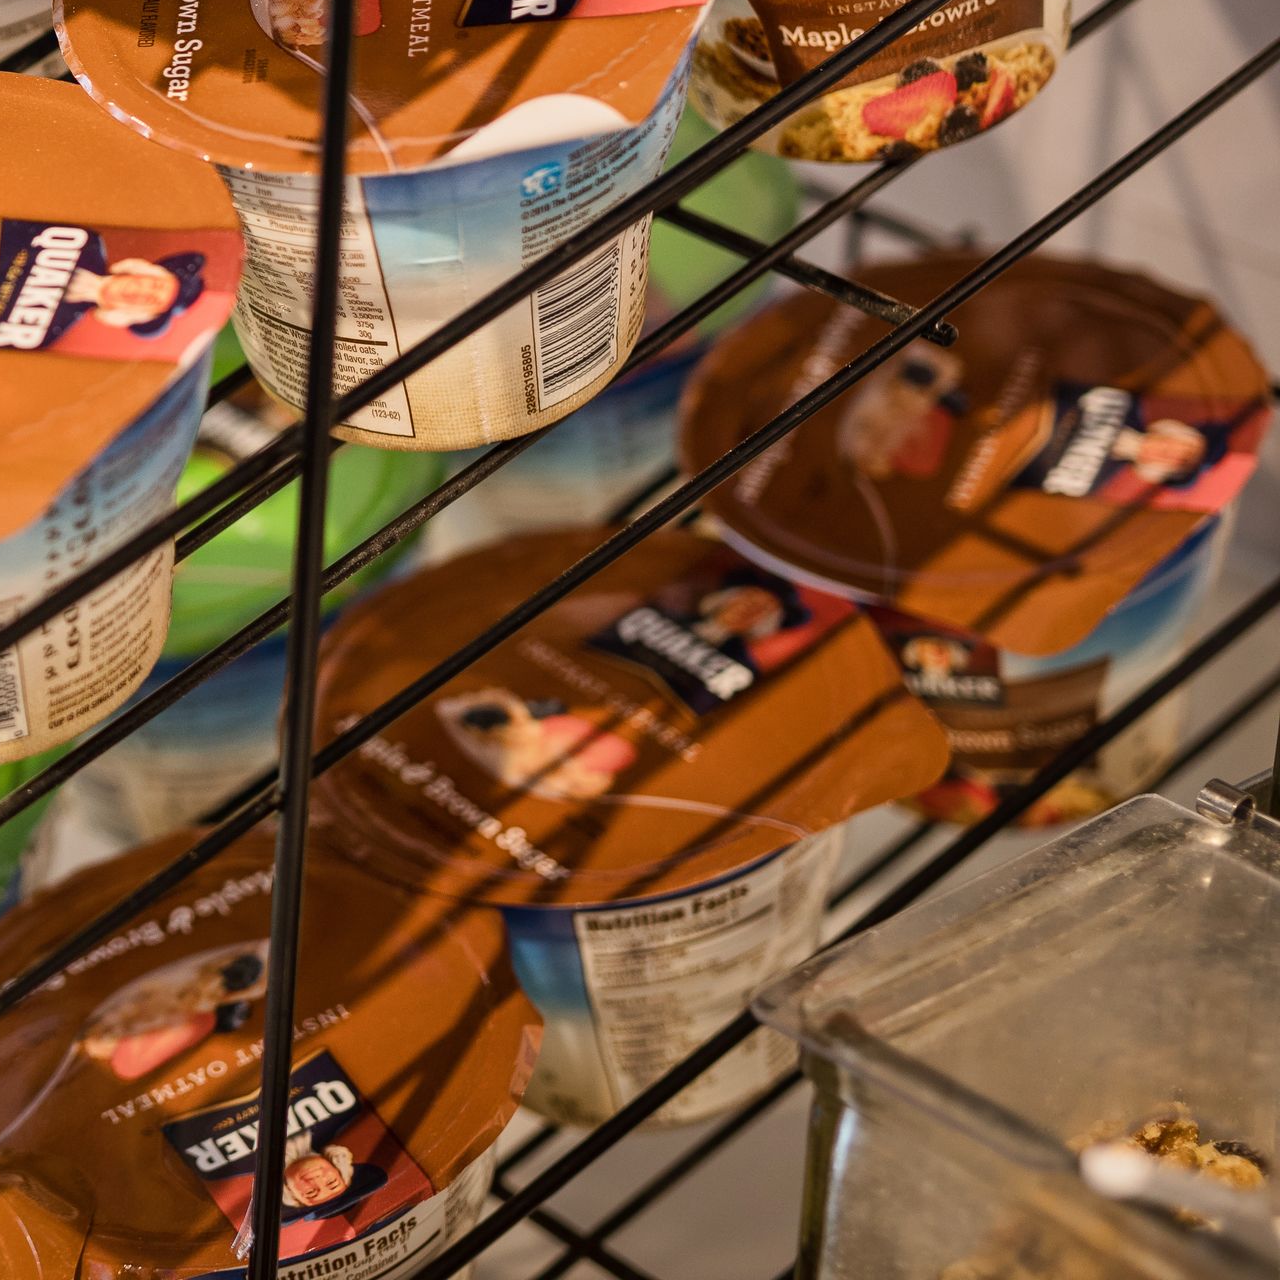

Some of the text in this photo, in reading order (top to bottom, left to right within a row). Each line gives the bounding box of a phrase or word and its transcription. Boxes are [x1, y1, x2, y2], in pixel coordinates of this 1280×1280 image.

[778, 22, 865, 53] Maple
[162, 39, 204, 102] Sugar
[350, 305, 383, 315] 2,400mg
[352, 312, 384, 322] 3,500mg
[356, 320, 375, 330] 375g
[358, 329, 373, 340] 30g
[343, 353, 368, 366] flavor,
[369, 356, 386, 367] salt,
[358, 345, 379, 357] oats,
[521, 344, 537, 416] 32863195805
[371, 408, 401, 421] (123-62)
[617, 607, 755, 701] QUAKER
[101, 1004, 351, 1125] INSTNT OATMEAL
[186, 1079, 358, 1173] QUKER
[278, 1215, 418, 1280] utrition Facts
